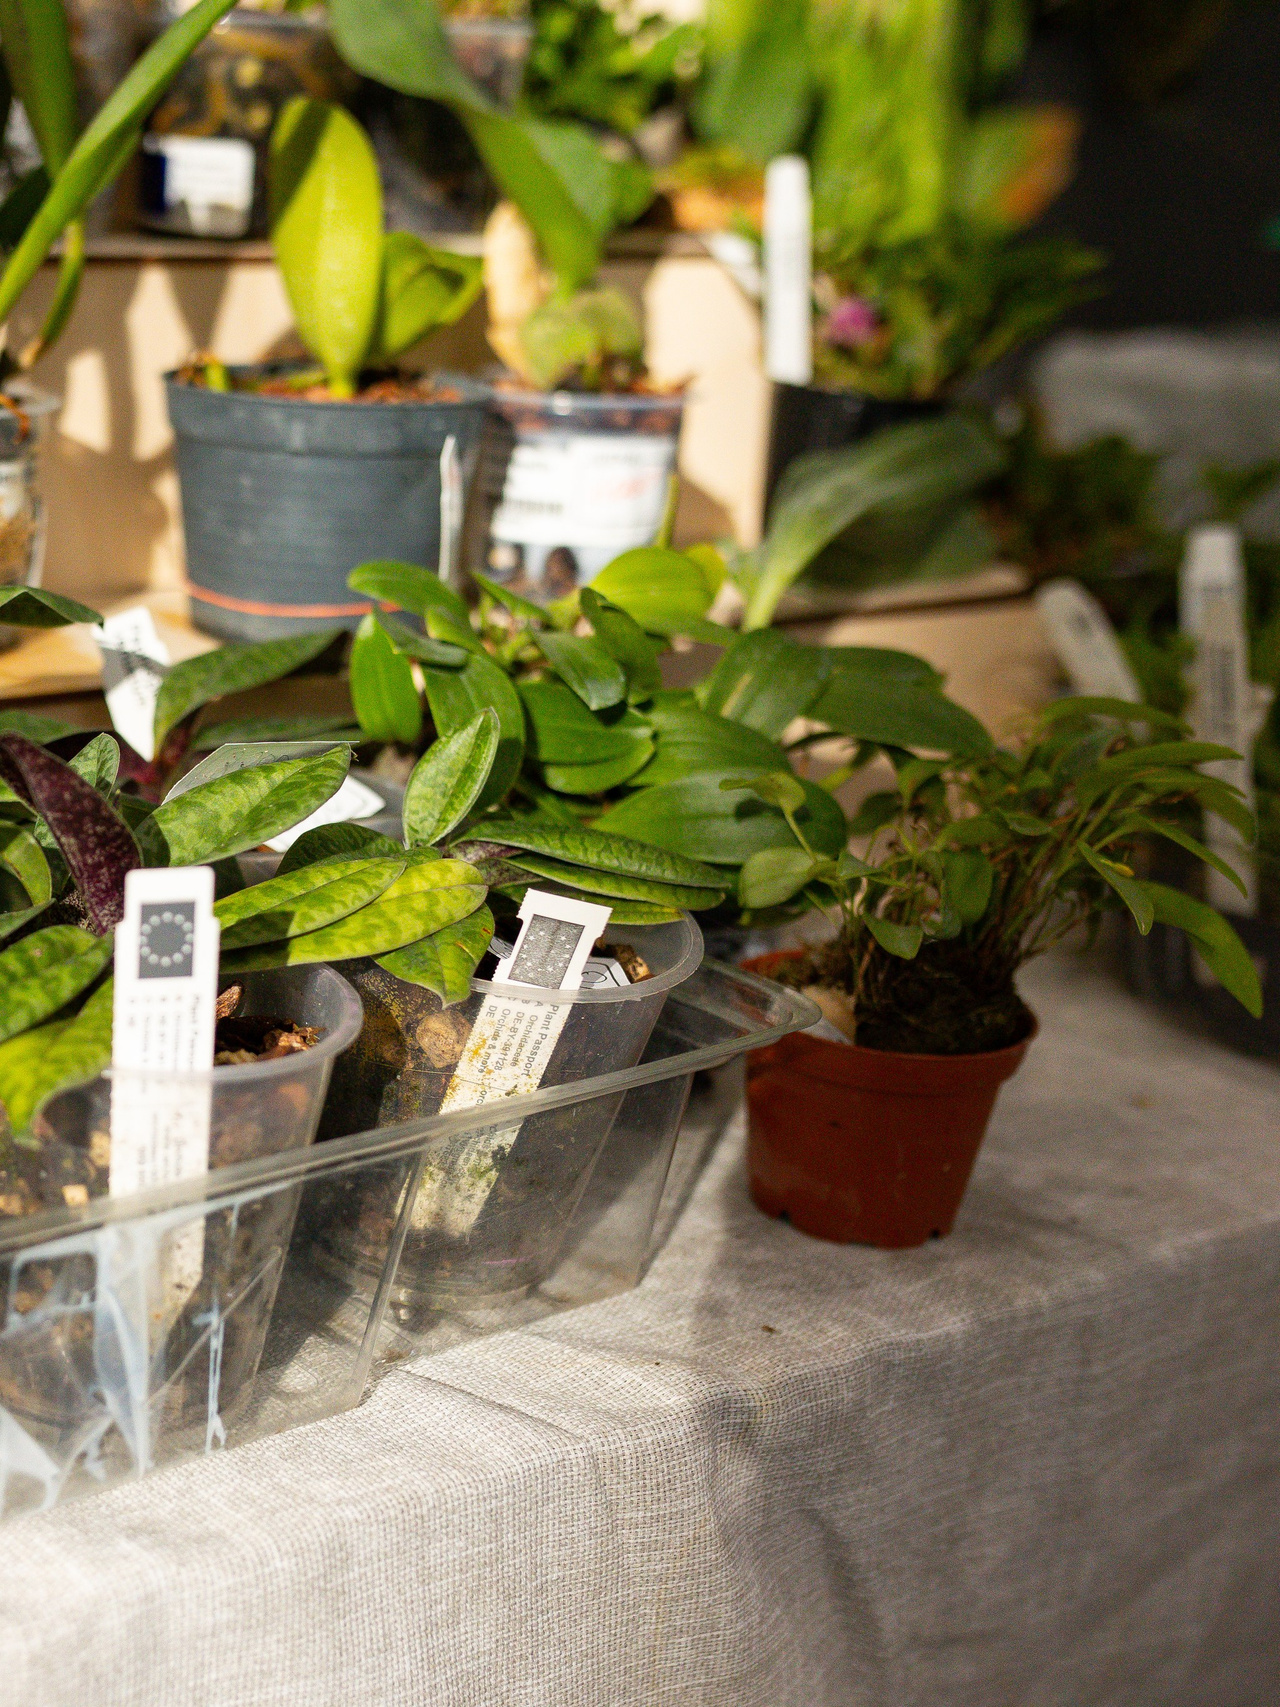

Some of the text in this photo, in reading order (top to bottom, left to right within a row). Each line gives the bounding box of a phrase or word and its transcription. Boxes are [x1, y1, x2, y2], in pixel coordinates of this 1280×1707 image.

[486, 1005, 498, 1018] DE
[521, 1004, 559, 1077] Plant Passport
